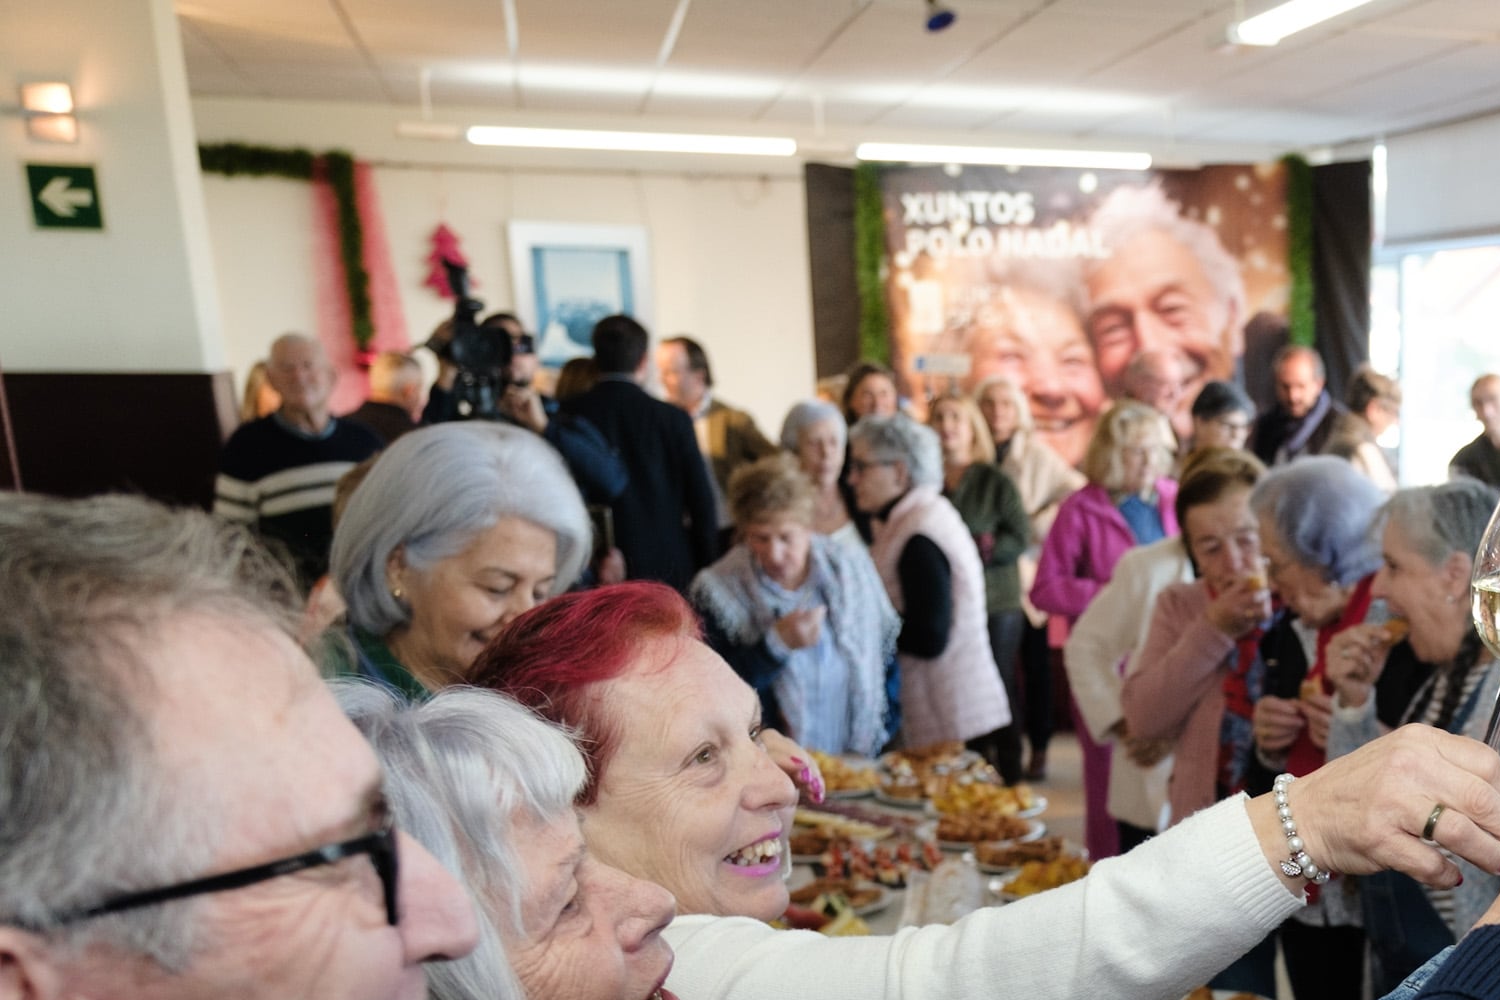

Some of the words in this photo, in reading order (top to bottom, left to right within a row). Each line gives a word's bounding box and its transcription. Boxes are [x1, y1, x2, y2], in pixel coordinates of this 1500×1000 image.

[902, 191, 1035, 225] XUNTOS
[905, 227, 993, 258] POLO
[998, 227, 1112, 258] NADAL
